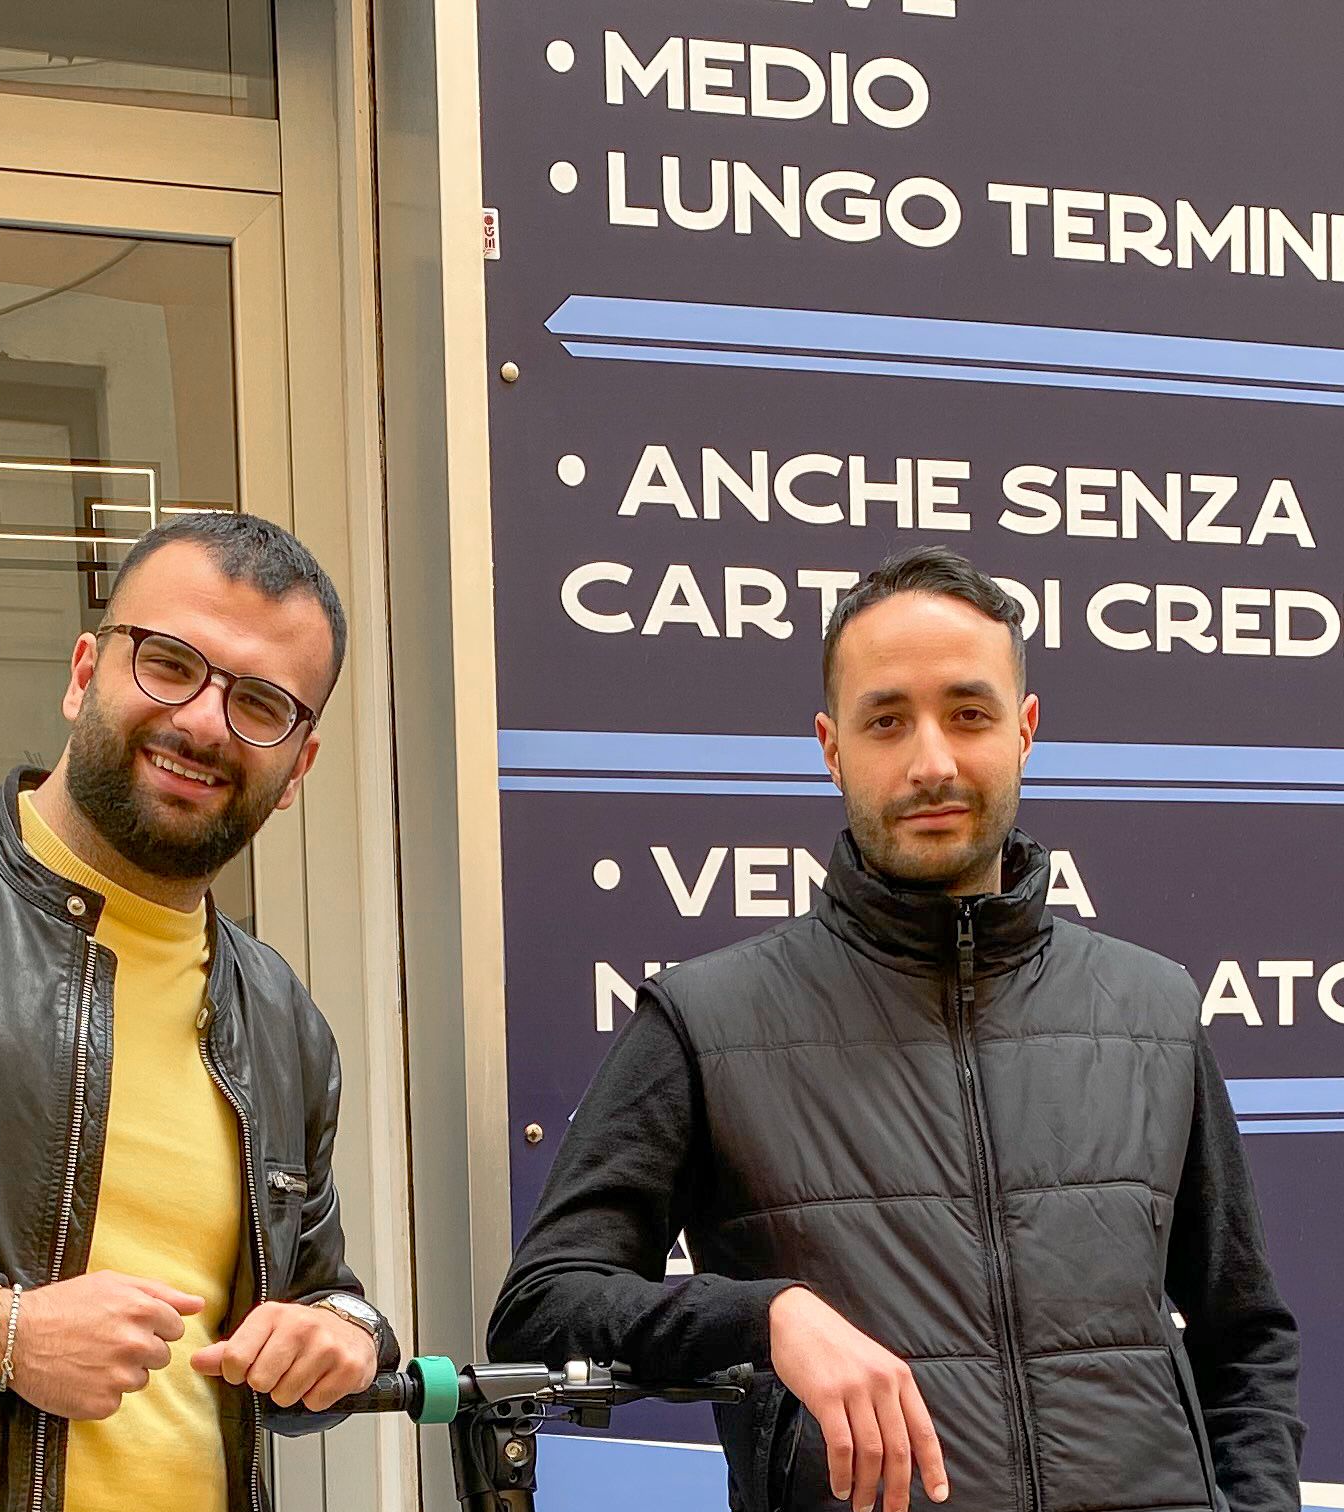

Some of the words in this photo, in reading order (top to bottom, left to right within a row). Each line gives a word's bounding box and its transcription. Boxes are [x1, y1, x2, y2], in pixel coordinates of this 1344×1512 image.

[603, 31, 929, 128] MEDIO
[606, 150, 961, 248] LUNGO
[617, 444, 971, 533] ANCHE
[998, 464, 1317, 549] SENZA
[559, 562, 856, 641] CART
